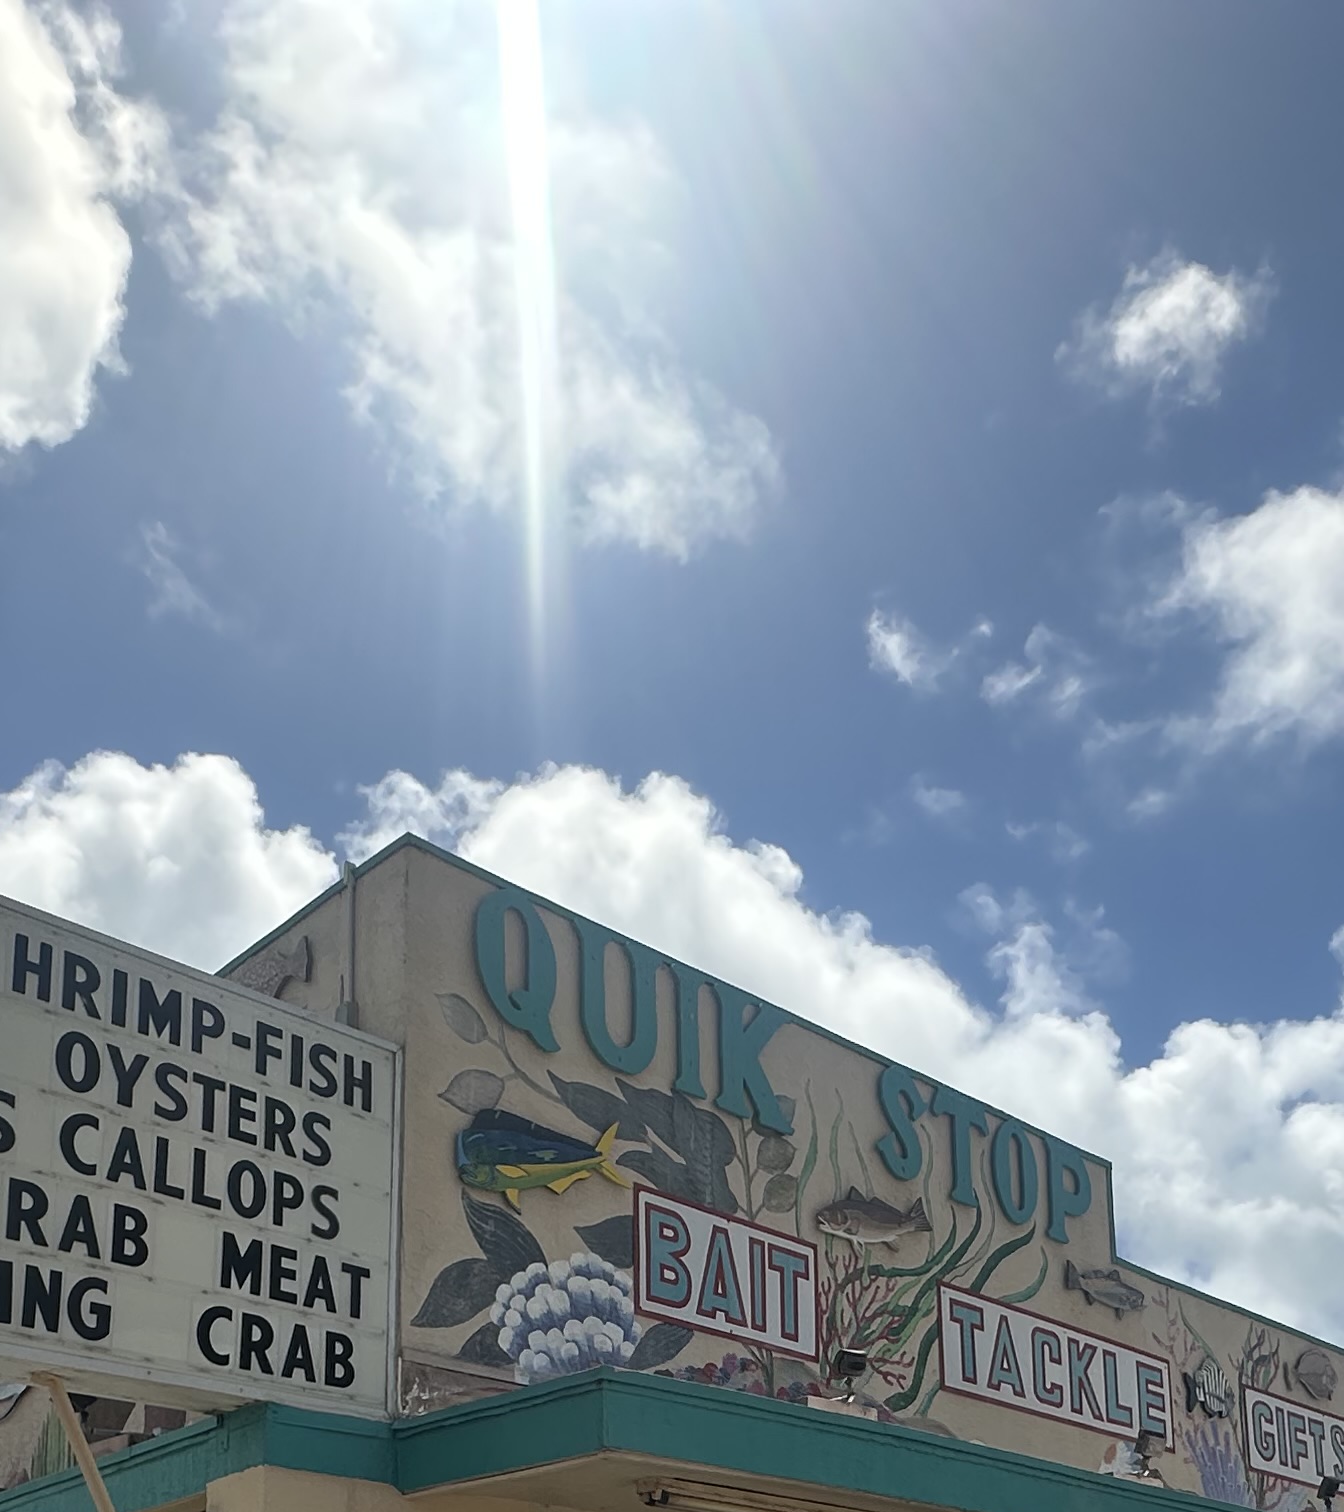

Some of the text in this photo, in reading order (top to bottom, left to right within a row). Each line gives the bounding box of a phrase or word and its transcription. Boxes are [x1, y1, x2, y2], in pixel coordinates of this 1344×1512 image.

[56, 1030, 332, 1168] OYSTERS
[475, 887, 1092, 1244] QUIK STOP
[219, 1231, 371, 1320] MEAT
[645, 1201, 810, 1343] BAIT
[196, 1305, 357, 1389] CRAB
[949, 1300, 1169, 1440] TACKLE
[1252, 1400, 1326, 1478] GIFT
